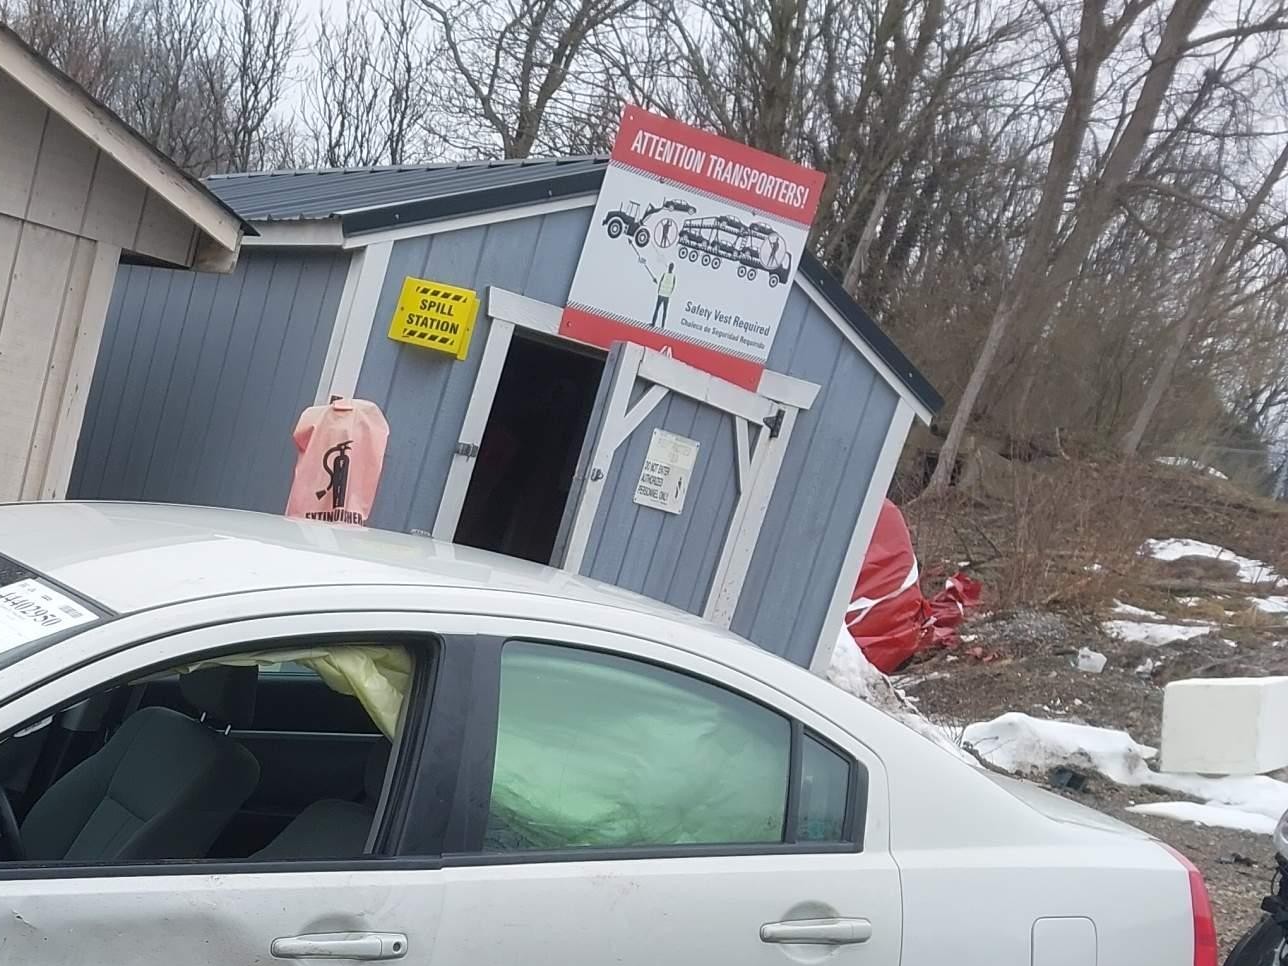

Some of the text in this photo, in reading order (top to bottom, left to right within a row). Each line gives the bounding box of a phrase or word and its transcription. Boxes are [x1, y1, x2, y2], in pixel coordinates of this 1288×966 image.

[630, 129, 810, 209] ATTENTION TRANSPORTERS!
[419, 298, 455, 318] SPILL
[685, 301, 771, 336] Safety Vest Required
[406, 312, 460, 336] STATION
